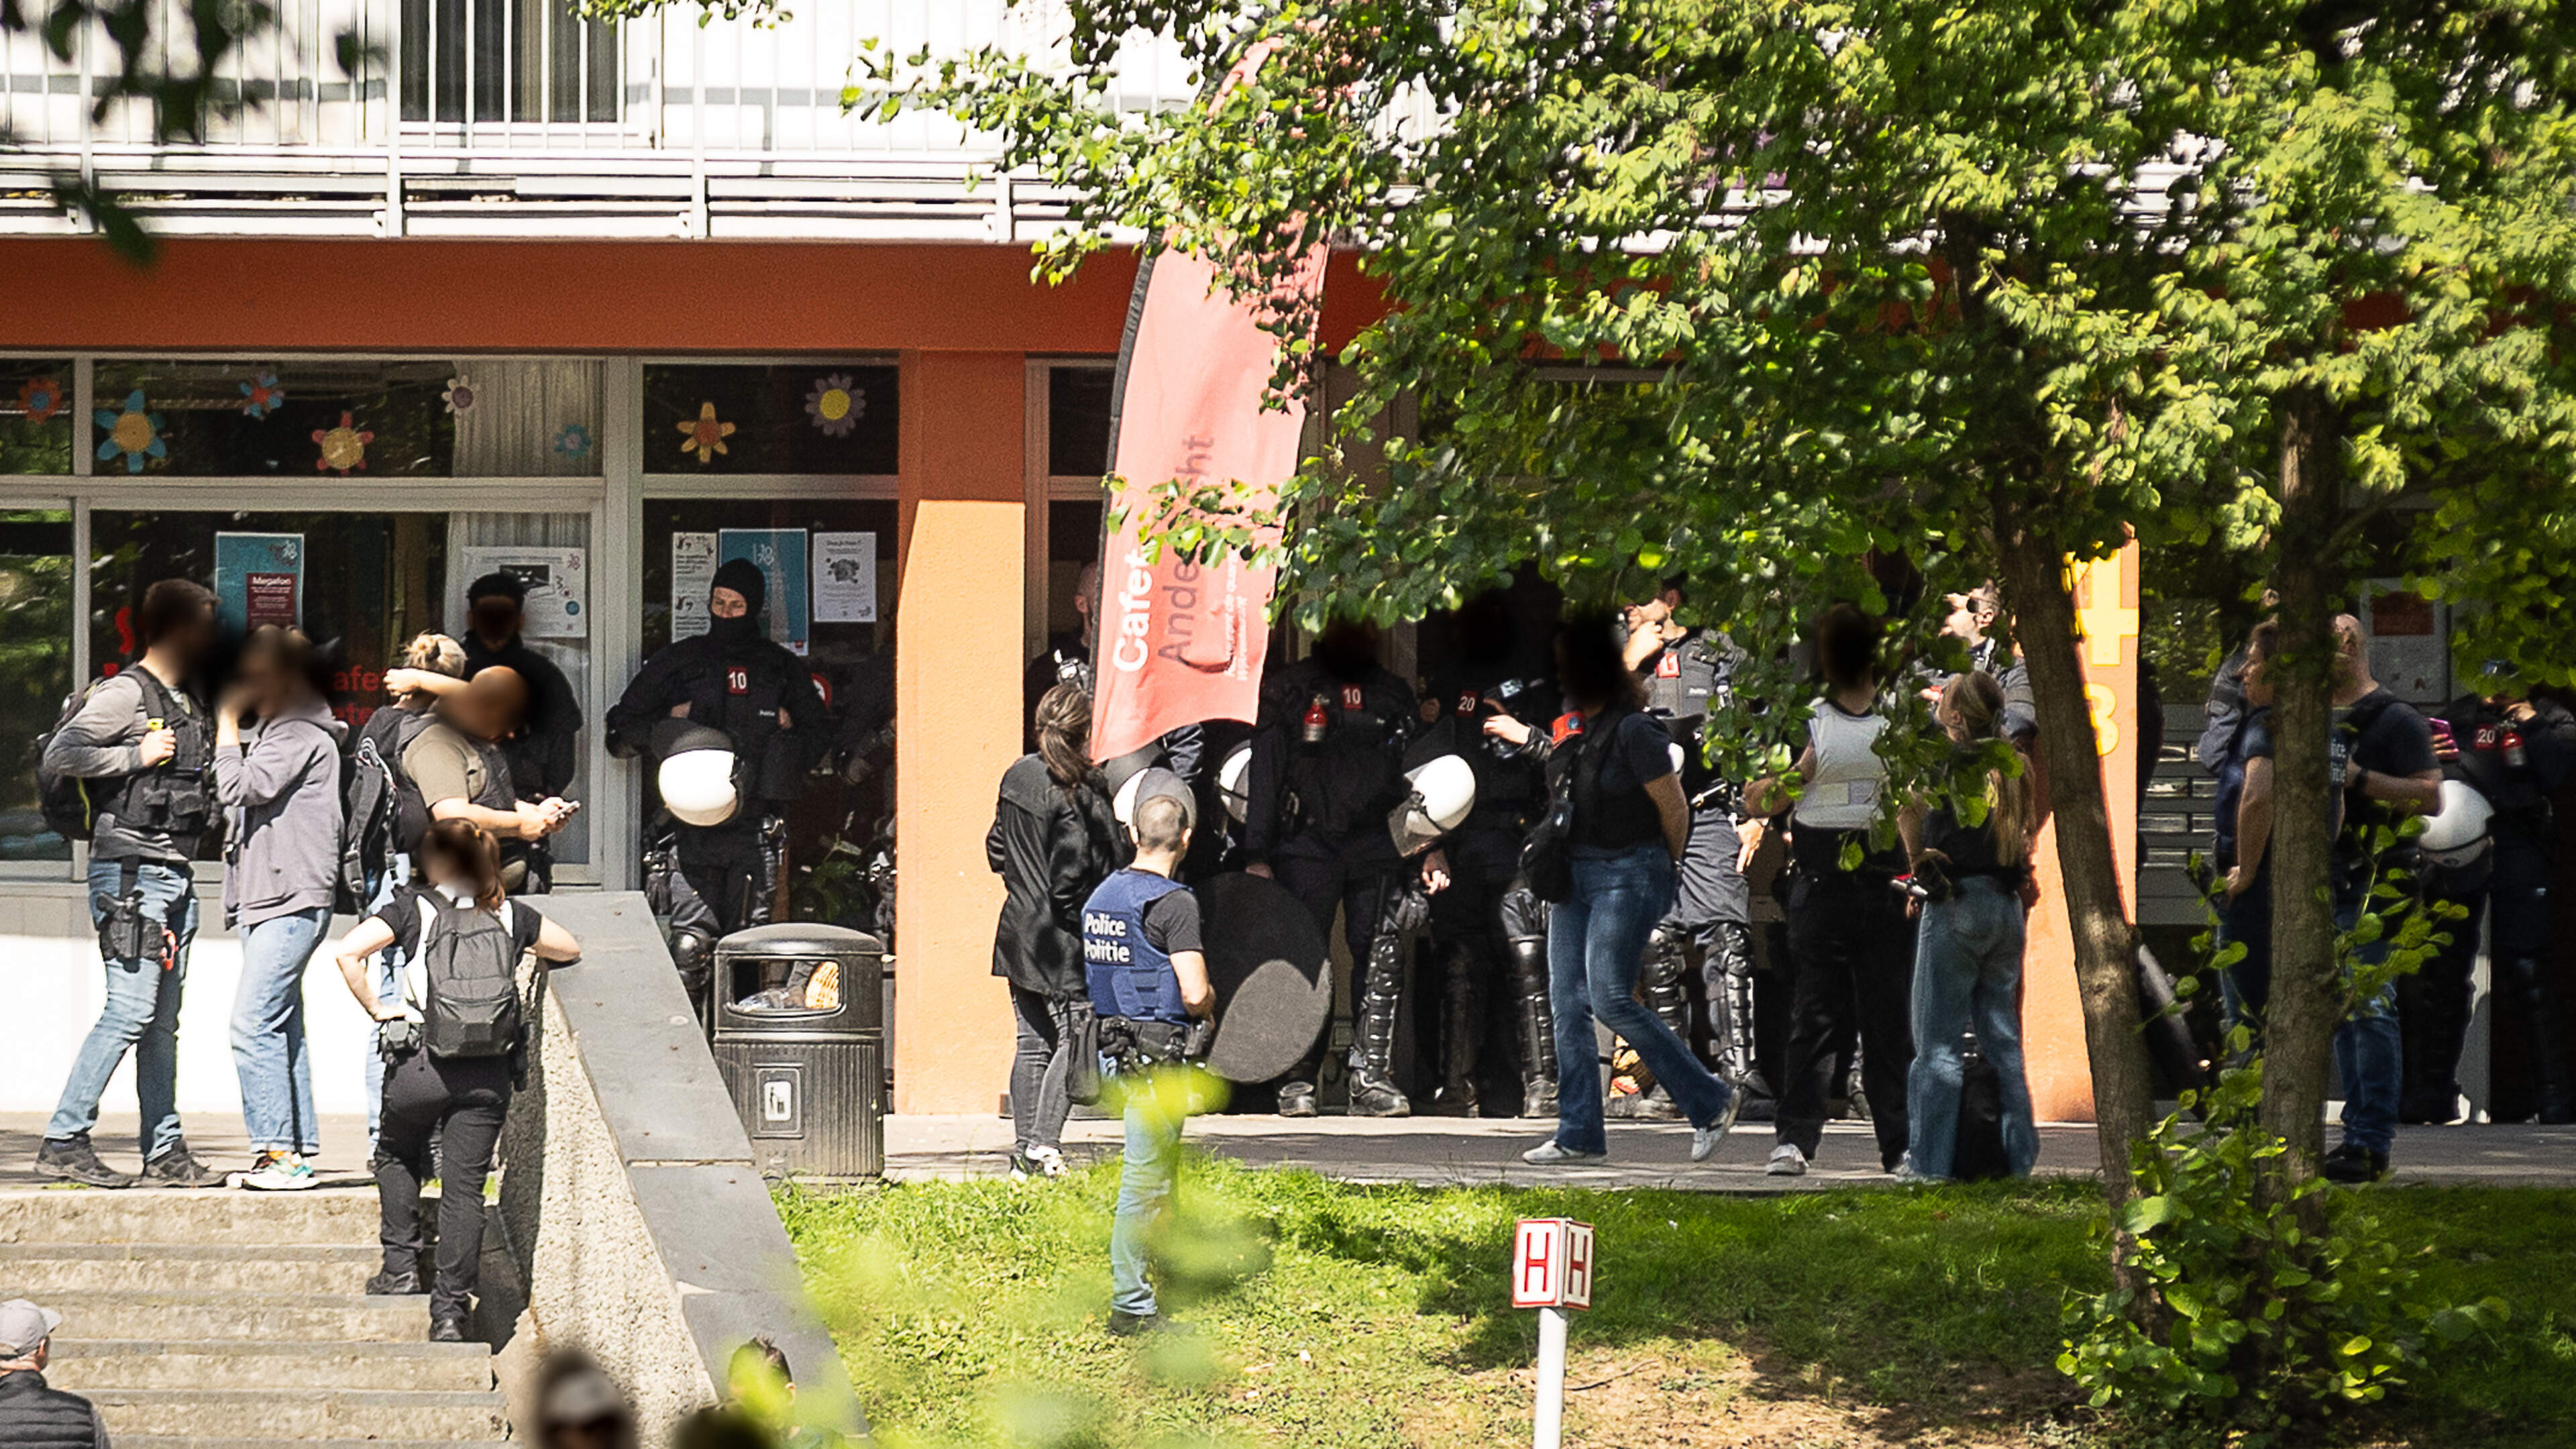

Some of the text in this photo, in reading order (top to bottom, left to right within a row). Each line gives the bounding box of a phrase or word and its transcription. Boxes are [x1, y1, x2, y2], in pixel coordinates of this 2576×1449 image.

[1158, 435, 1214, 663] Andeht
[729, 672, 747, 690] 10
[1343, 688, 1361, 704] 10
[1458, 696, 1475, 712] 20
[2478, 729, 2496, 744] 20
[1085, 912, 1126, 936] Police
[1084, 938, 1130, 962] Politie
[1524, 1232, 1550, 1293] H
[1568, 1232, 1589, 1297] H
